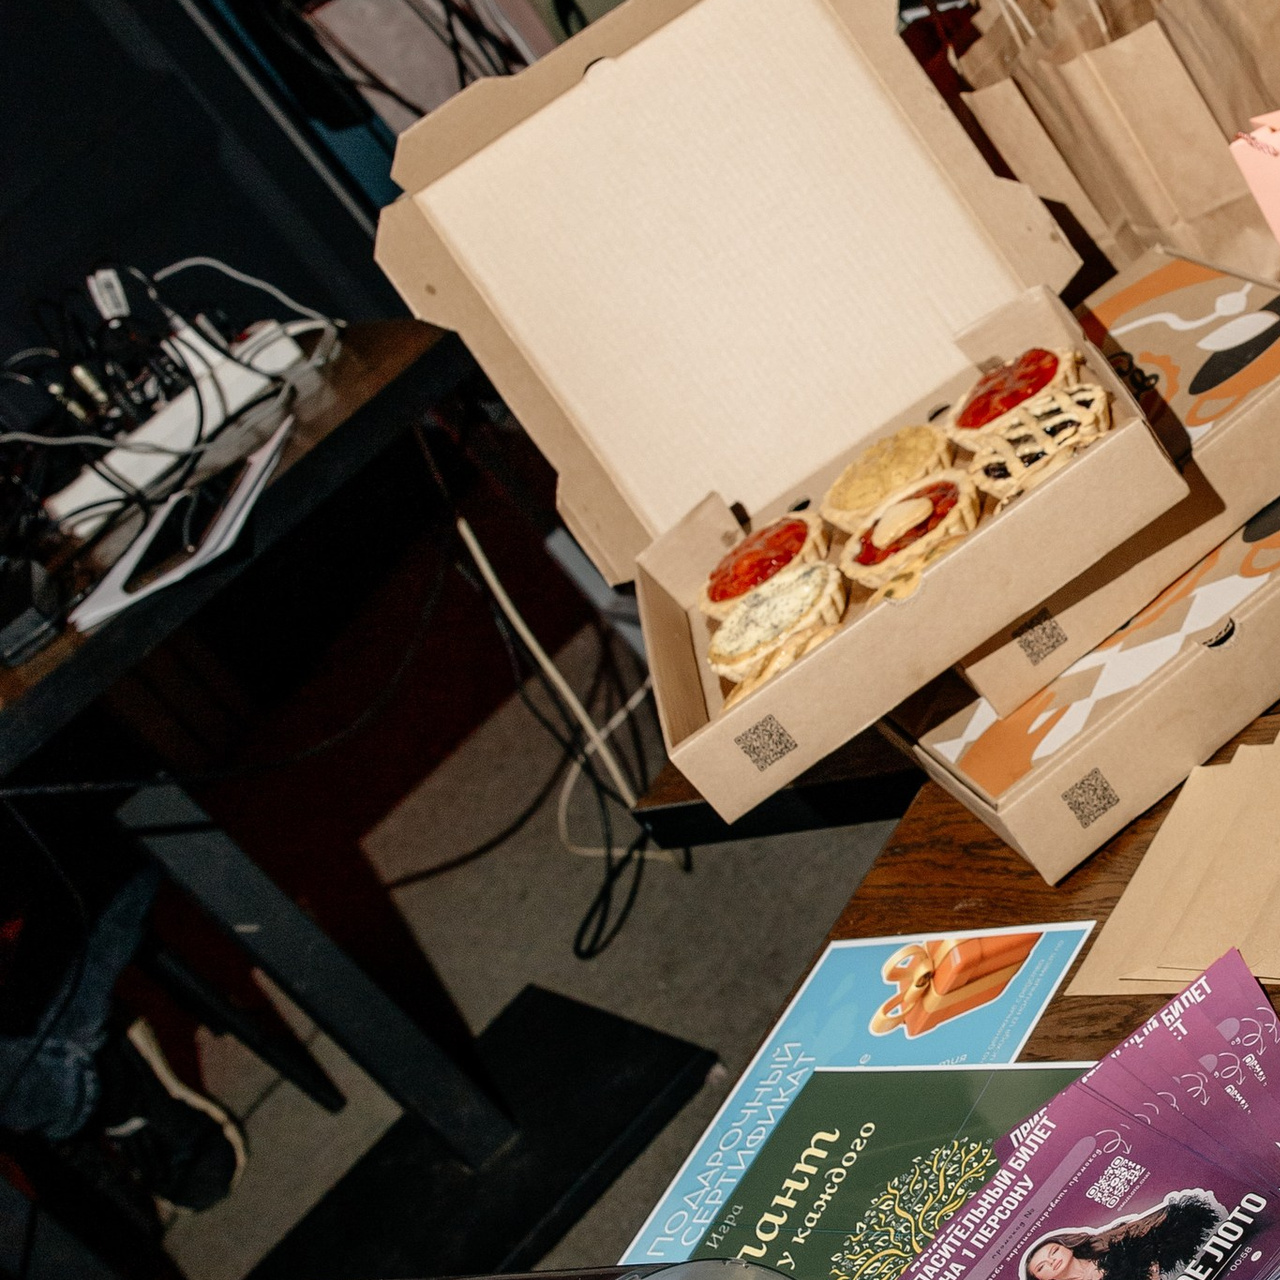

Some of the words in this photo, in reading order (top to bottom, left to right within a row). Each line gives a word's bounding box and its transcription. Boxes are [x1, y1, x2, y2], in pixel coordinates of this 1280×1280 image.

[646, 1043, 801, 1256] ПОДАРОЧНЫЙ
[681, 1052, 815, 1246] СЕРТИФИКАТ
[1008, 1115, 1056, 1171] БИЛЕТ
[1069, 1149, 1102, 1186] промокод
[706, 1205, 743, 1249] Игра
[777, 1252, 795, 1270] у
[792, 1123, 875, 1244] каждого
[961, 1248, 976, 1259] 1
[970, 1174, 1033, 1249] ПЕРСОНУ
[1201, 1193, 1267, 1262] ЛОТО
